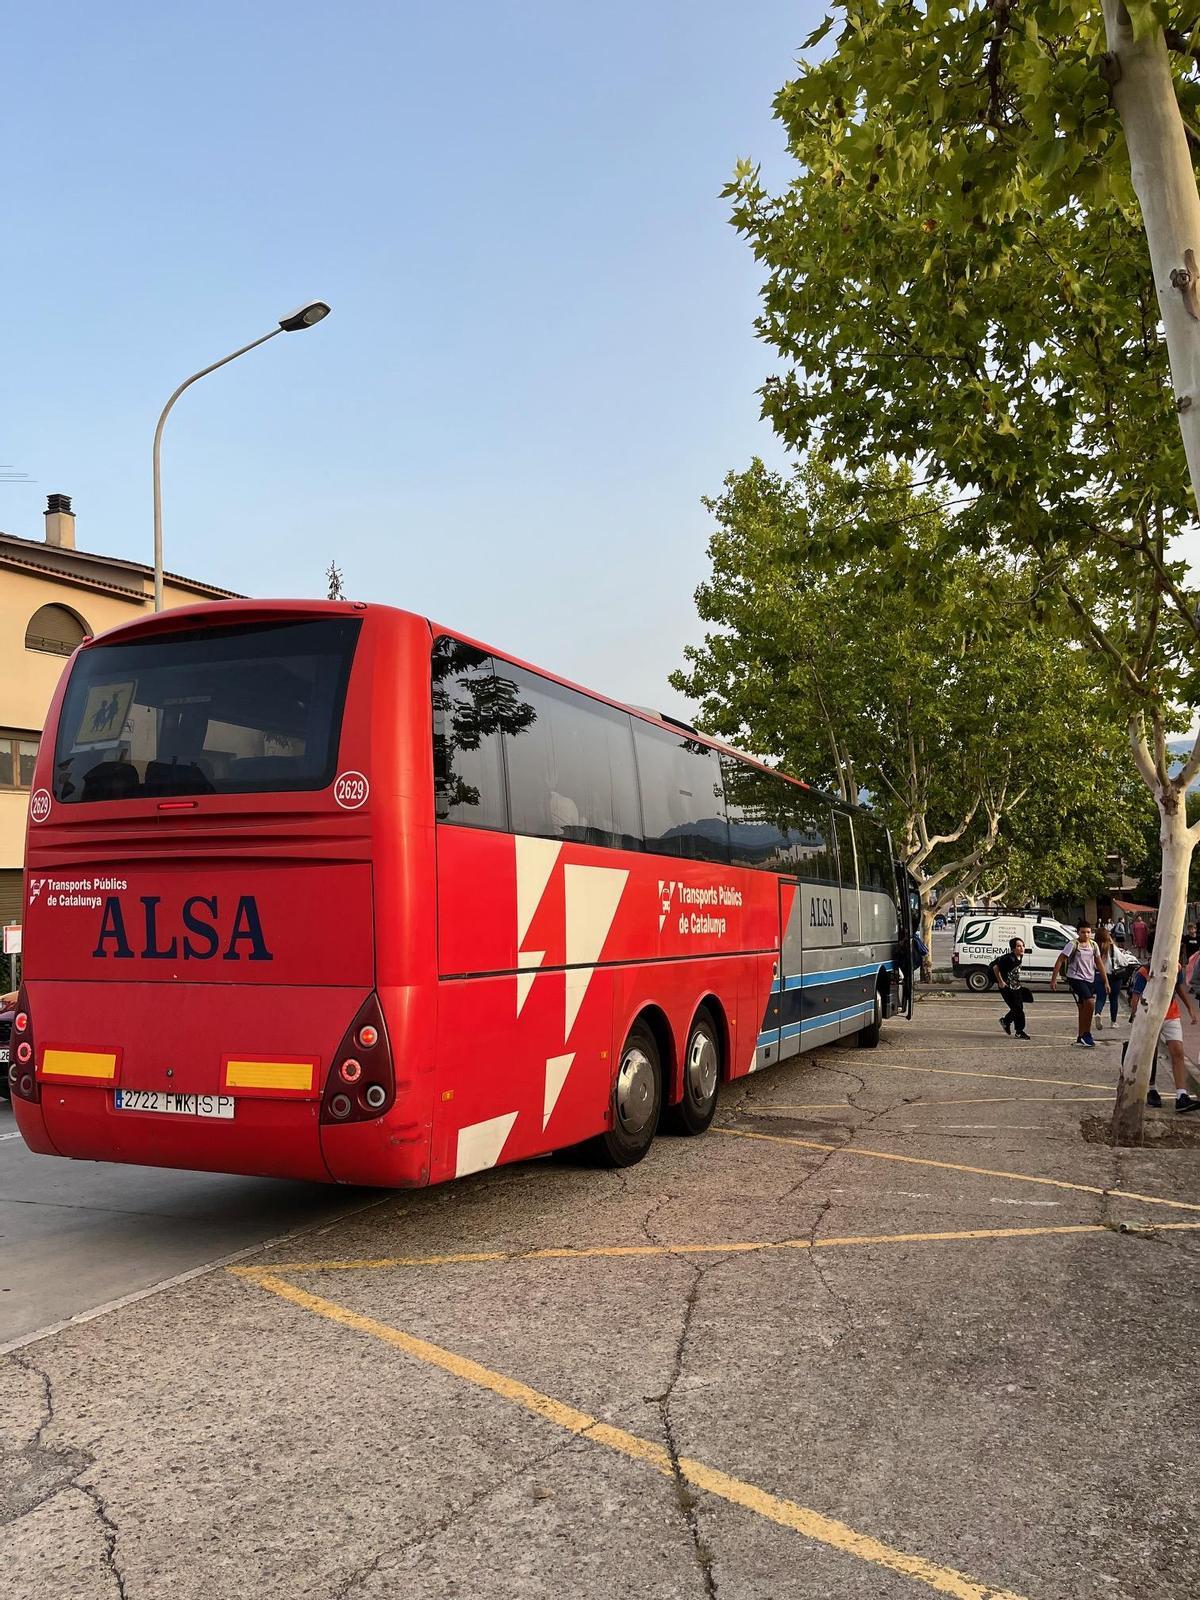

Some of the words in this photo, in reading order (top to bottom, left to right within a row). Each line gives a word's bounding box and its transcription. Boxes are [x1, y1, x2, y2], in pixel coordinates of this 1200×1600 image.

[338, 779, 364, 800] 2629
[33, 796, 49, 814] 2629
[47, 879, 92, 893] Transports
[93, 877, 128, 890] Públics
[677, 882, 718, 910] Transports
[719, 885, 743, 907] Públics
[47, 895, 57, 906] de
[59, 894, 102, 909] Catalunya
[809, 897, 835, 927] ALSA
[92, 895, 274, 961] ALSA
[679, 912, 689, 934] de
[690, 912, 726, 938] Catalunya
[962, 946, 1010, 954] ECOTERMI
[125, 1090, 159, 1110] 2722
[166, 1093, 192, 1113] FWK
